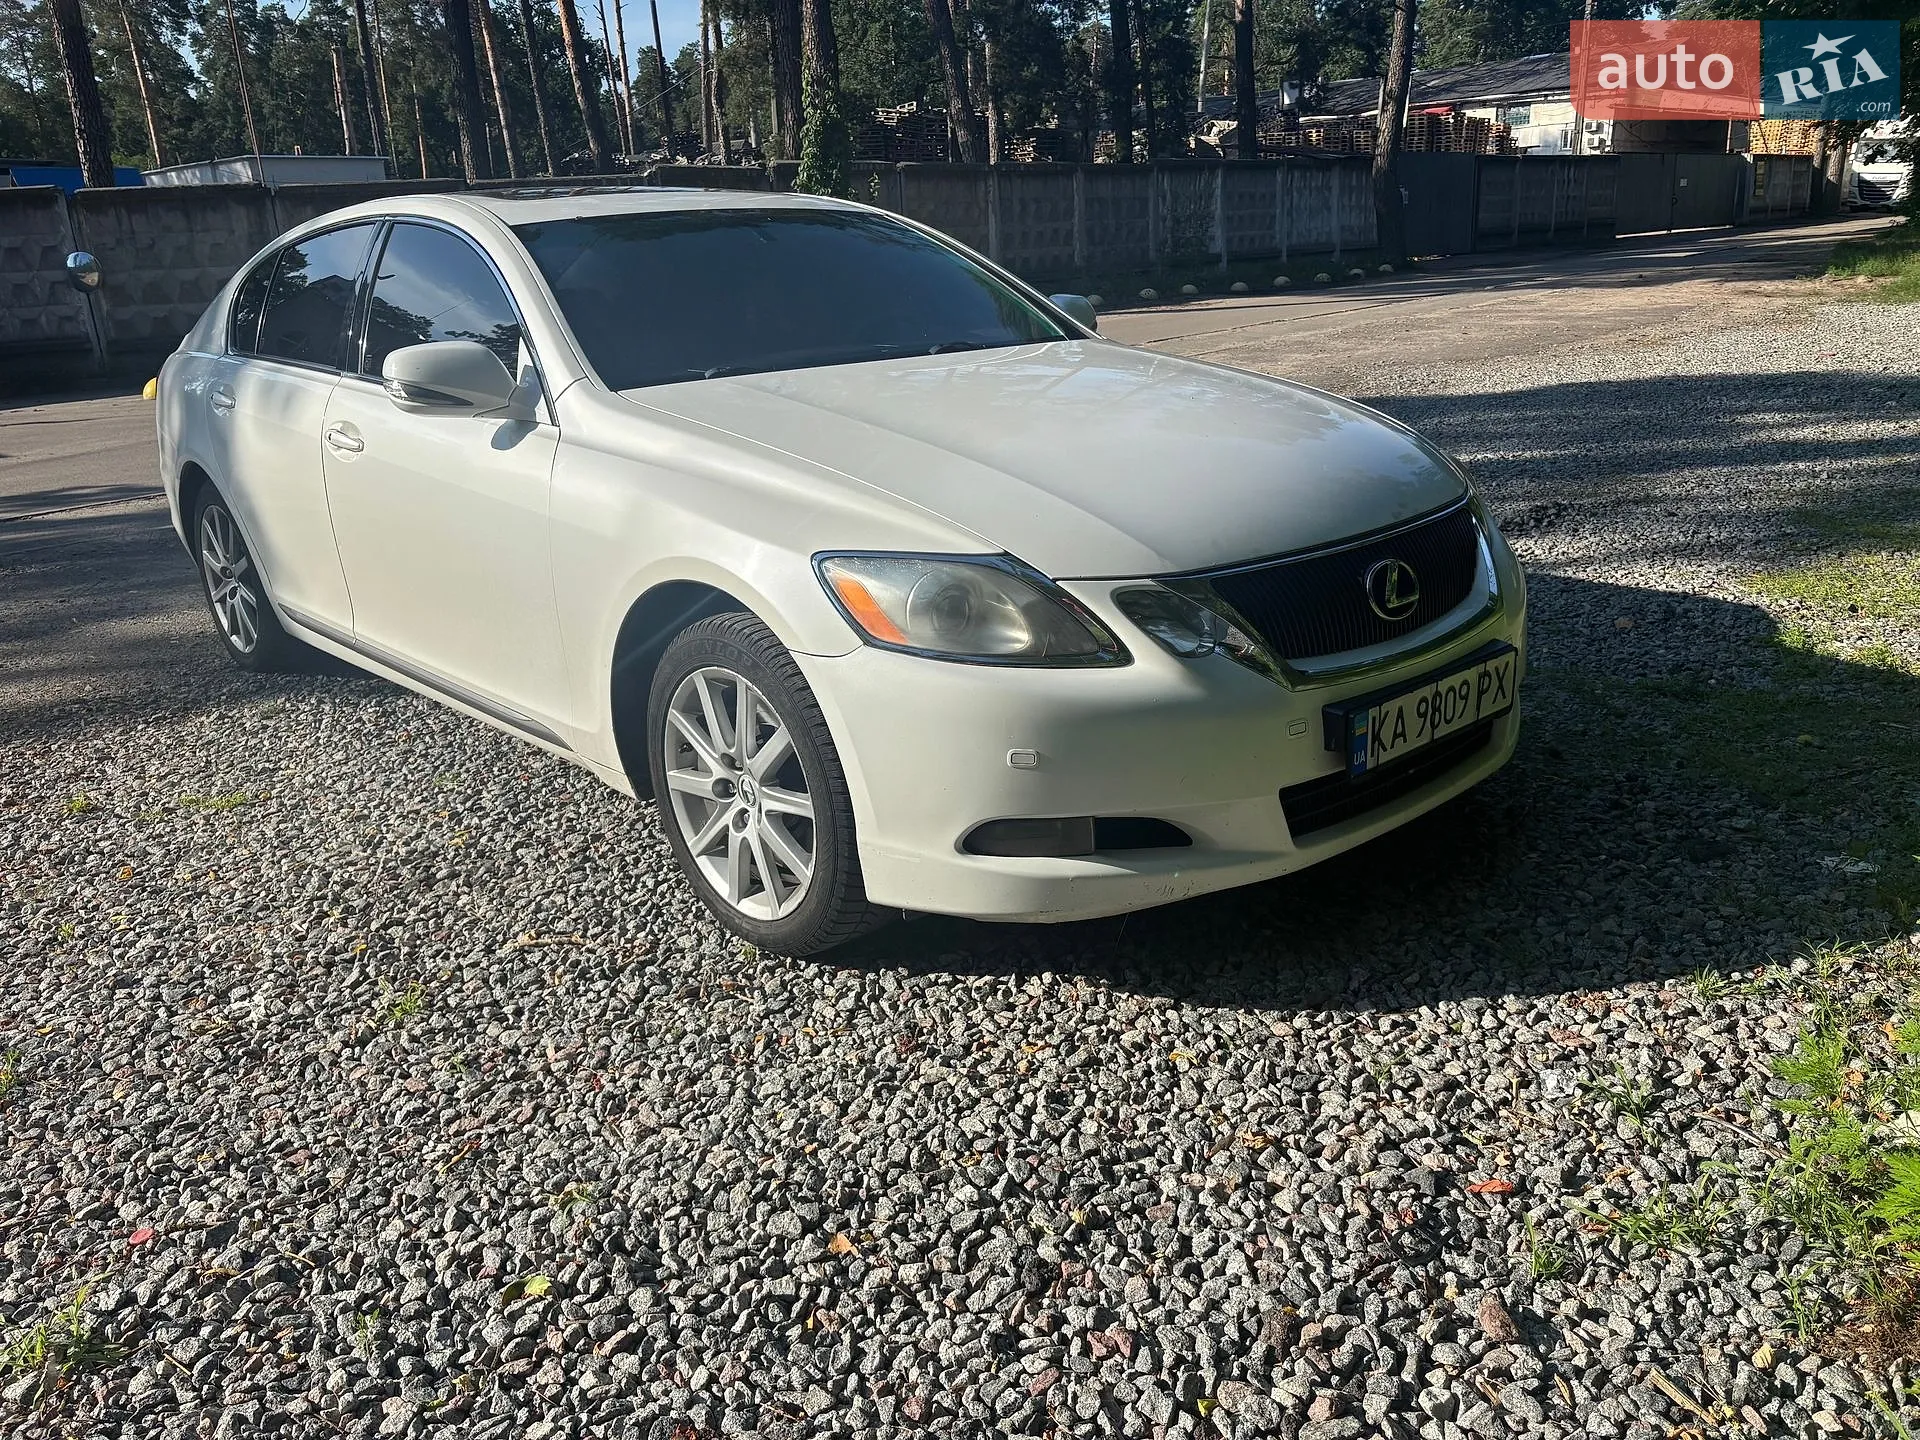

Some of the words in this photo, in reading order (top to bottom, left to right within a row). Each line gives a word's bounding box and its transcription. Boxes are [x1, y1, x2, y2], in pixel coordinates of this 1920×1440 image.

[1370, 706, 1408, 758] KA
[1416, 679, 1471, 739] 9809
[1477, 660, 1510, 713] PX
[1354, 750, 1366, 765] UA
